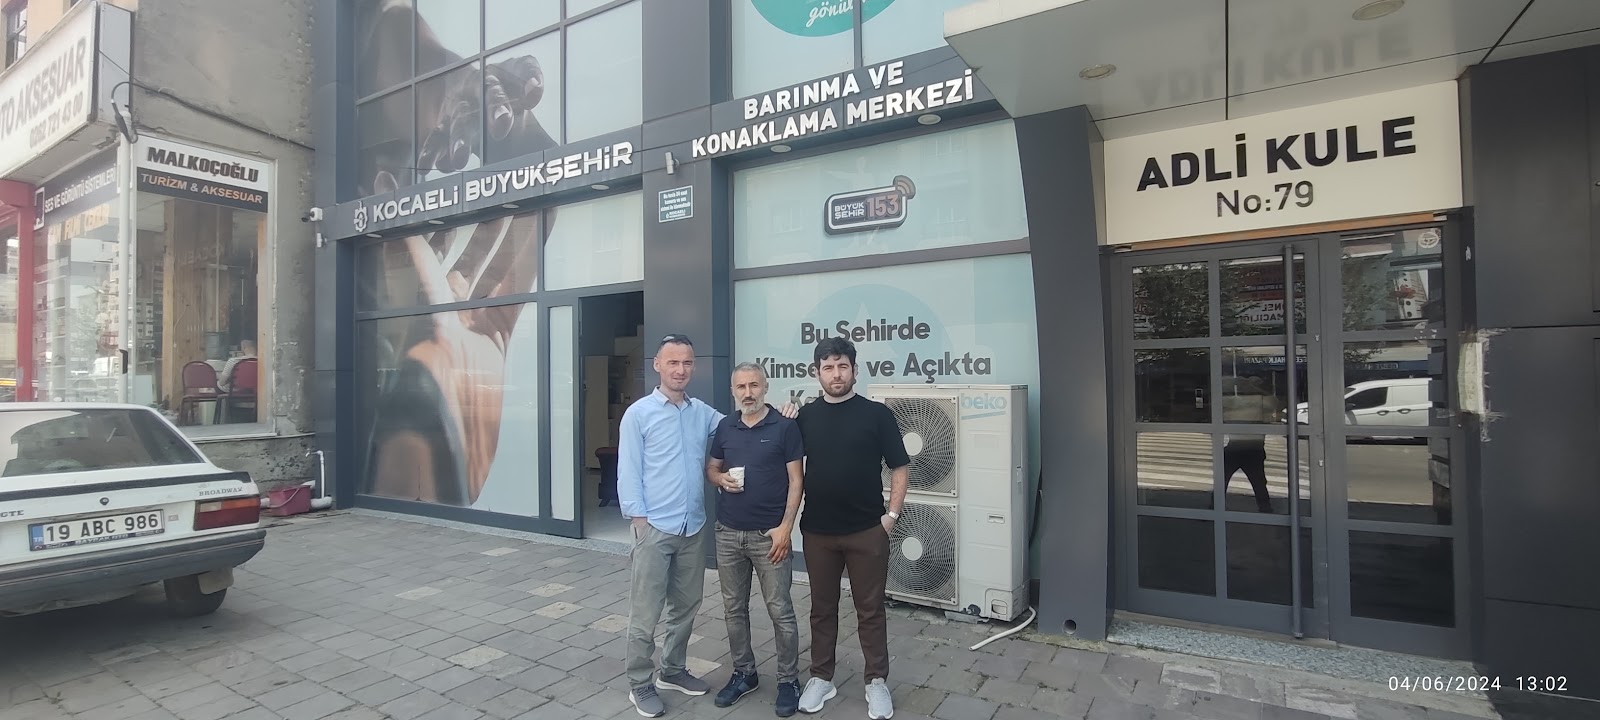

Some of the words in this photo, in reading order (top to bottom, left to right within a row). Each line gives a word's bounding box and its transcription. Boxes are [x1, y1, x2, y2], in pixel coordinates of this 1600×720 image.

[15, 36, 87, 131] AKSESUAR
[744, 73, 860, 121] BARINMA
[867, 61, 904, 90] VE
[692, 110, 838, 158] KONAKLAMA
[846, 68, 975, 126] MERKEZİ
[147, 146, 260, 183] MALKOÇOĞLU
[1136, 132, 1248, 192] ADLİ
[1265, 116, 1417, 174] KULE
[140, 173, 188, 191] TURİZM
[190, 182, 199, 193] &
[200, 184, 263, 205] AKSESUAR
[834, 202, 865, 212] BÜYÜK
[866, 194, 899, 217] 153
[1216, 180, 1314, 218] No:79
[801, 322, 829, 345] Bu
[866, 360, 895, 377] ve
[902, 351, 992, 384] Açıkta
[960, 392, 1008, 411] beko
[198, 487, 243, 497] BROADWAY
[46, 524, 71, 542] 19
[80, 518, 116, 537] ABC
[124, 513, 159, 531] 986
